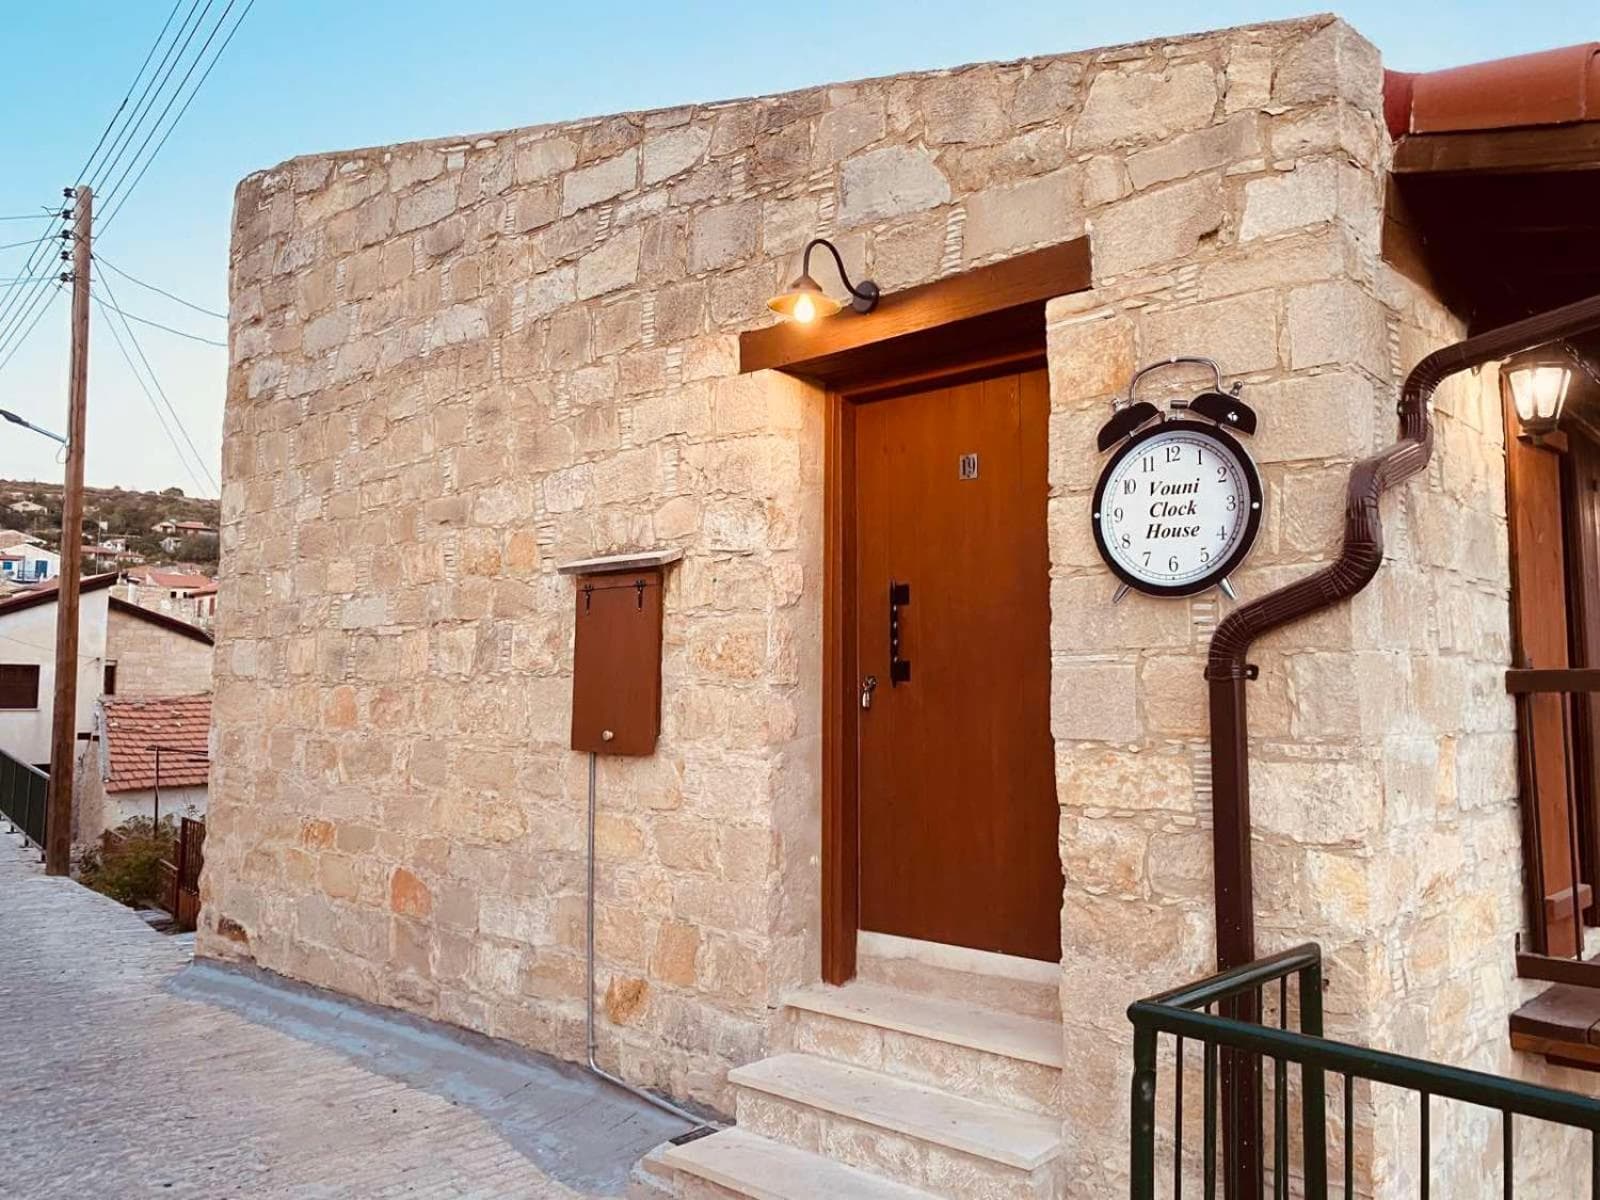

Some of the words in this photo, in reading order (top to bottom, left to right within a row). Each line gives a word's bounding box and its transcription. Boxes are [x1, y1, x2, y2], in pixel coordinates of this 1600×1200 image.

[1166, 446, 1180, 463] 12
[1197, 449, 1203, 465] 1
[1143, 456, 1155, 473] 11
[1217, 466, 1228, 483] 2
[1123, 479, 1136, 495] 10
[1149, 478, 1200, 496] Vouni
[1149, 501, 1197, 518] Clock
[1226, 495, 1236, 512] 3
[1114, 508, 1123, 523] 9
[1146, 523, 1200, 540] House
[1217, 525, 1228, 541] 4
[1122, 534, 1131, 549] 8
[1143, 551, 1152, 568] 7
[1169, 556, 1179, 572] 6
[1200, 547, 1210, 564] 5
